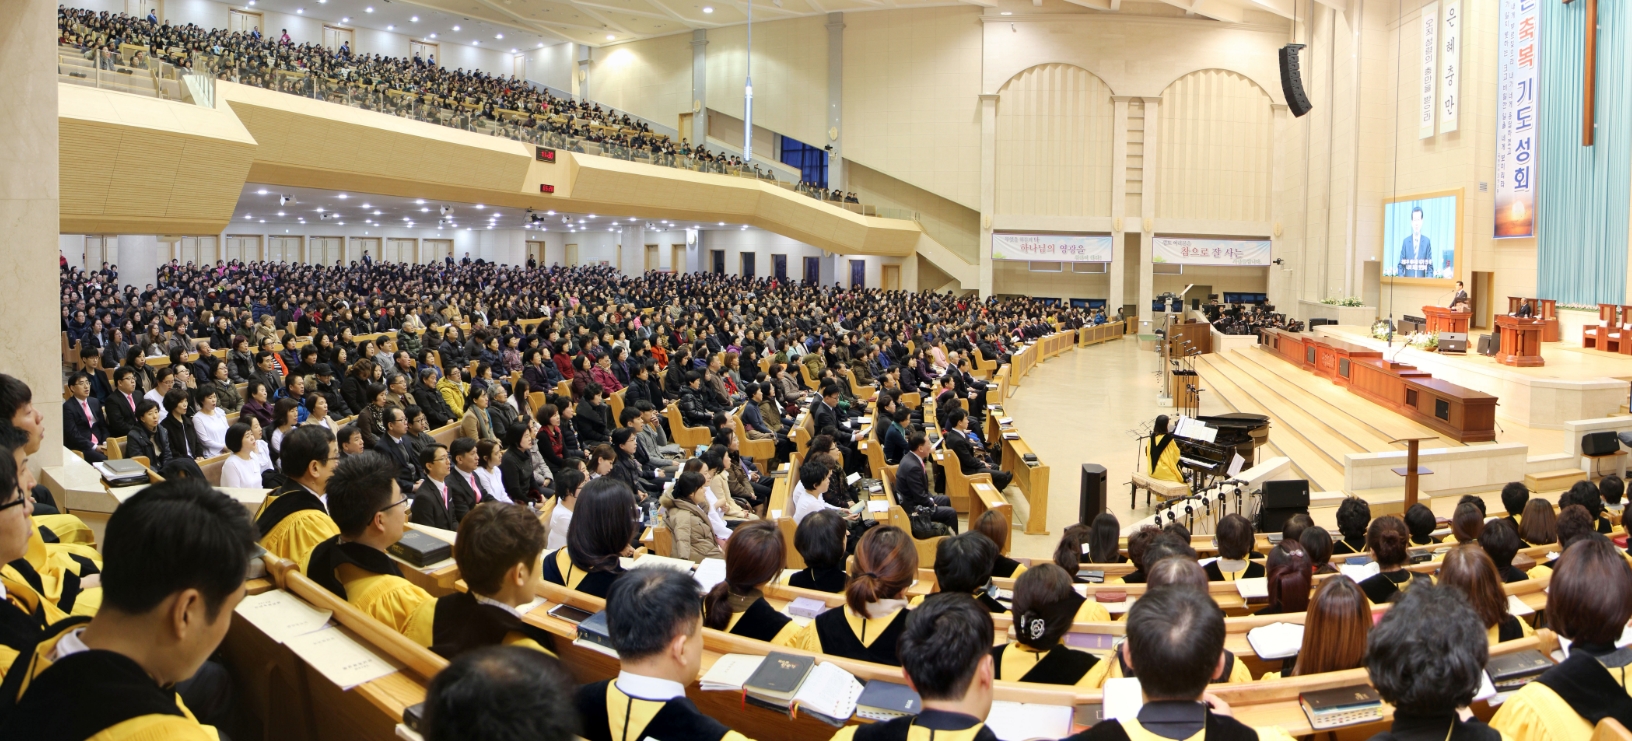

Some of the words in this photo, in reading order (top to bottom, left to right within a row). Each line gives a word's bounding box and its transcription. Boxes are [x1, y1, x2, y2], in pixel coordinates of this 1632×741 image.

[1425, 19, 1433, 36] 오직
[1425, 37, 1433, 64] 성령의
[1424, 67, 1432, 93] 충만을
[1423, 95, 1431, 122] 받으라
[1020, 243, 1055, 254] 하나님의
[1059, 244, 1086, 254] 영광을
[1181, 246, 1210, 257] 참으로
[1212, 247, 1222, 258] 잘
[1224, 247, 1244, 258] 사는
